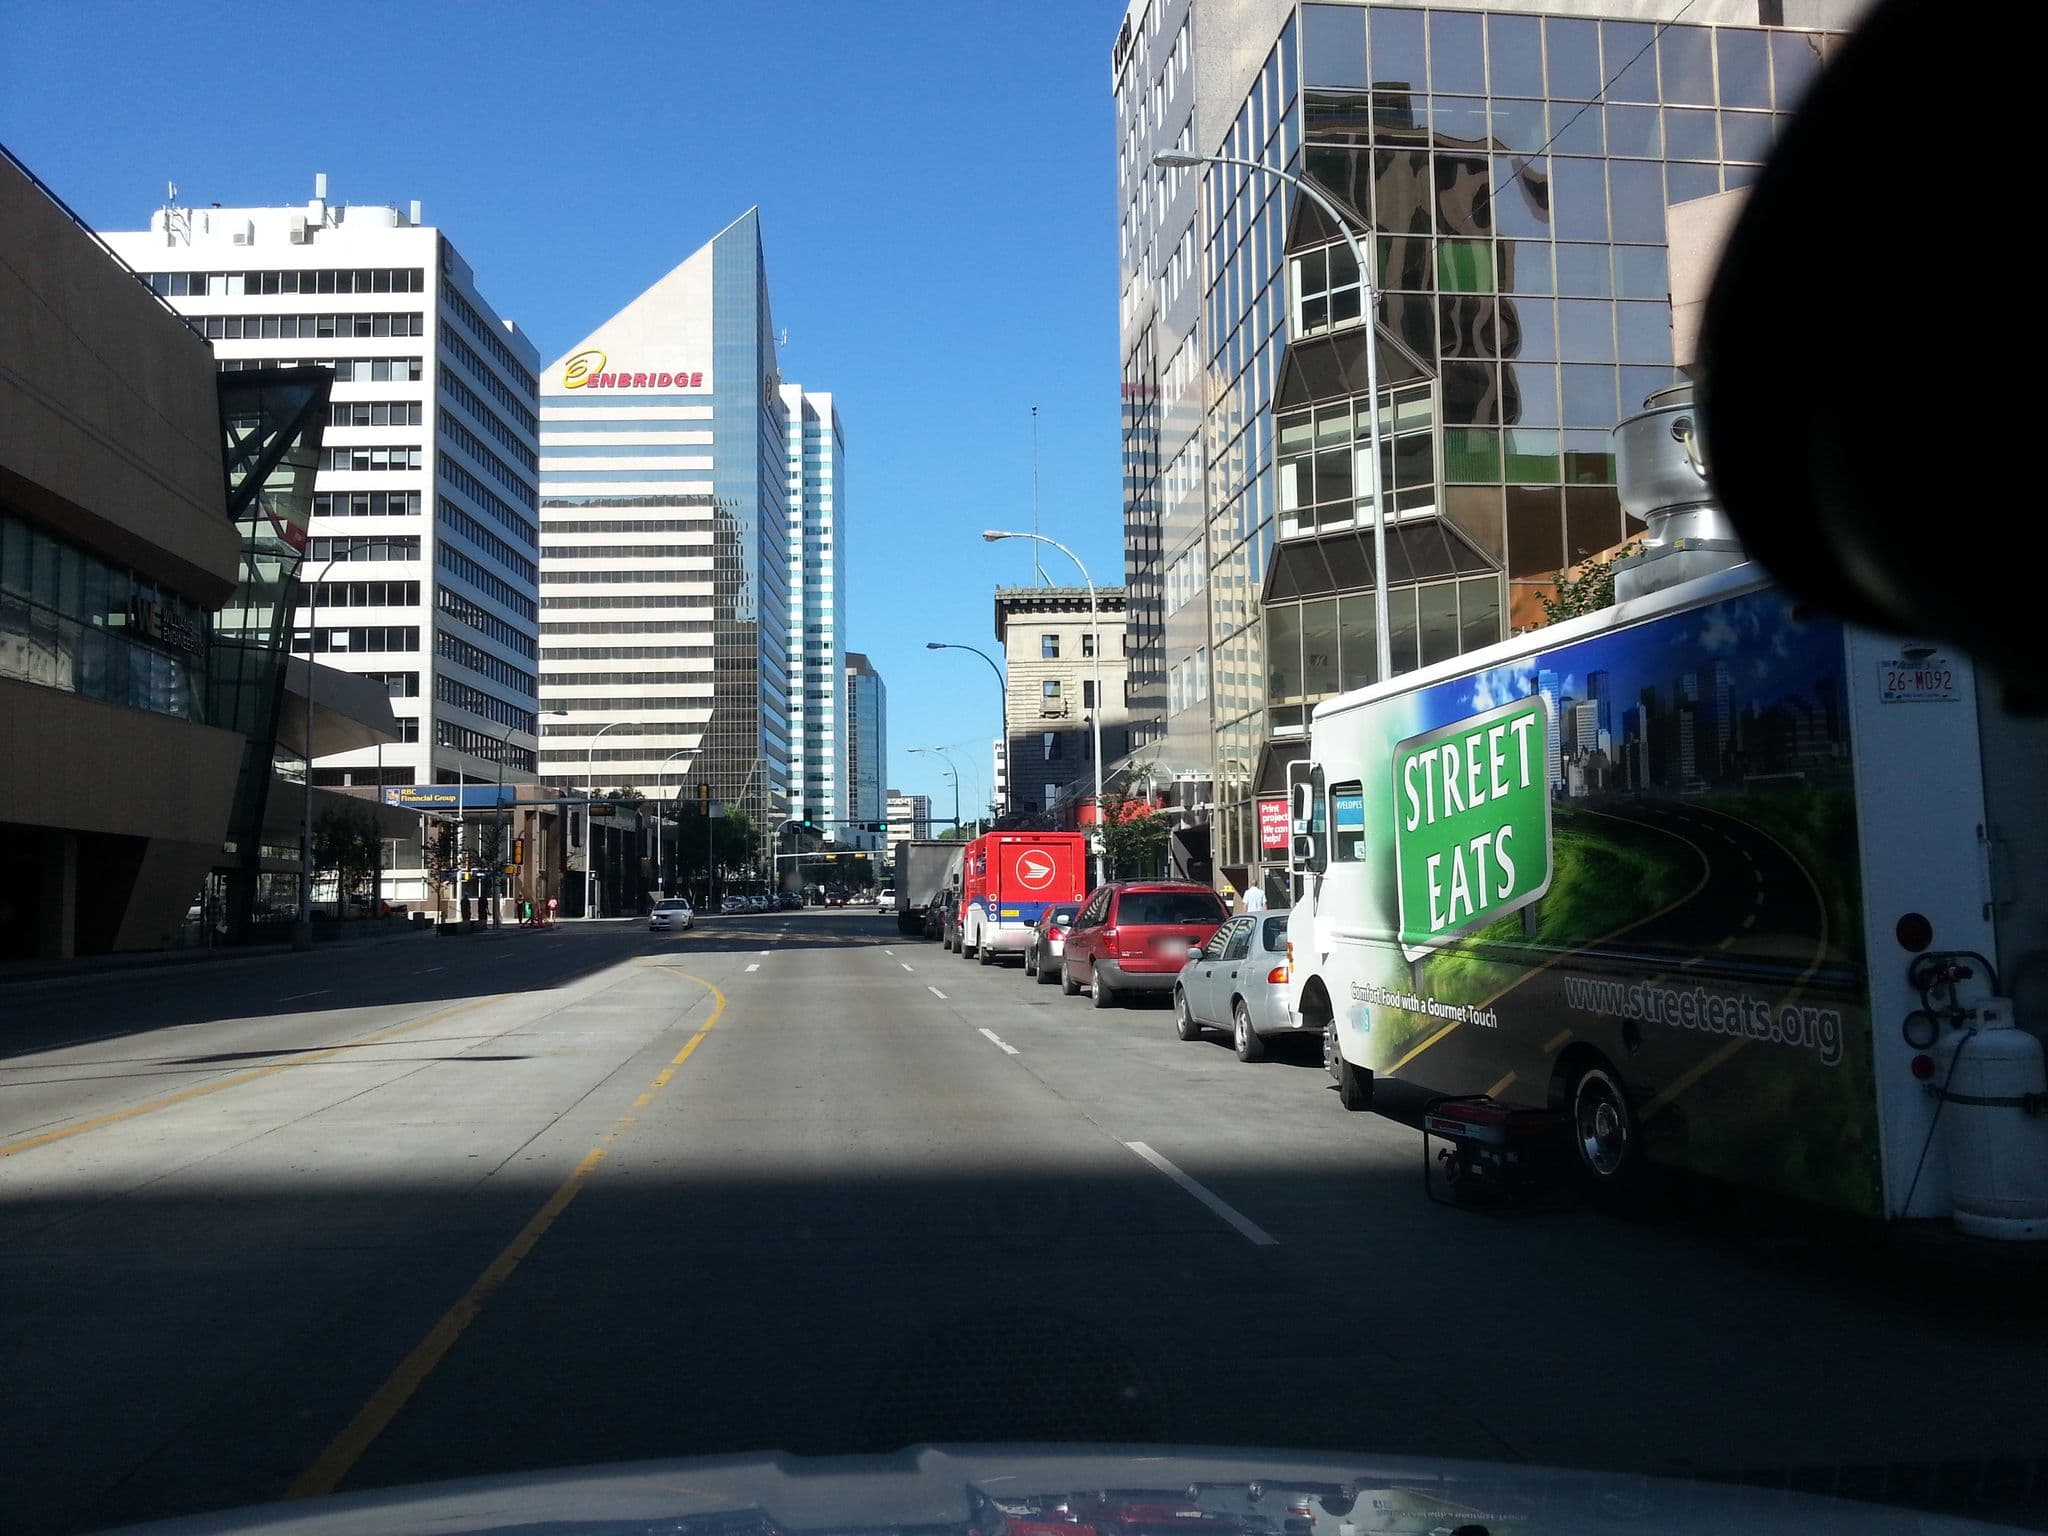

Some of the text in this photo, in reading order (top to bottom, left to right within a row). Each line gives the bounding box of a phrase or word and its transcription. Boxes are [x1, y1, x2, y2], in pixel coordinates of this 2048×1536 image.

[587, 372, 704, 389] ENBRIDGE
[1887, 670, 1953, 692] 26-M092
[1404, 712, 1536, 832] STREET
[434, 795, 456, 803] Group
[1261, 804, 1280, 813] Print
[1262, 813, 1288, 825] project
[1263, 824, 1274, 834] We
[1274, 826, 1288, 834] can
[1264, 833, 1282, 845] help!
[1425, 825, 1516, 933] EATS
[1350, 981, 1498, 1029] Comfort Food with a Gourmet Touch
[1564, 976, 1843, 1067] www.streeteats.org
